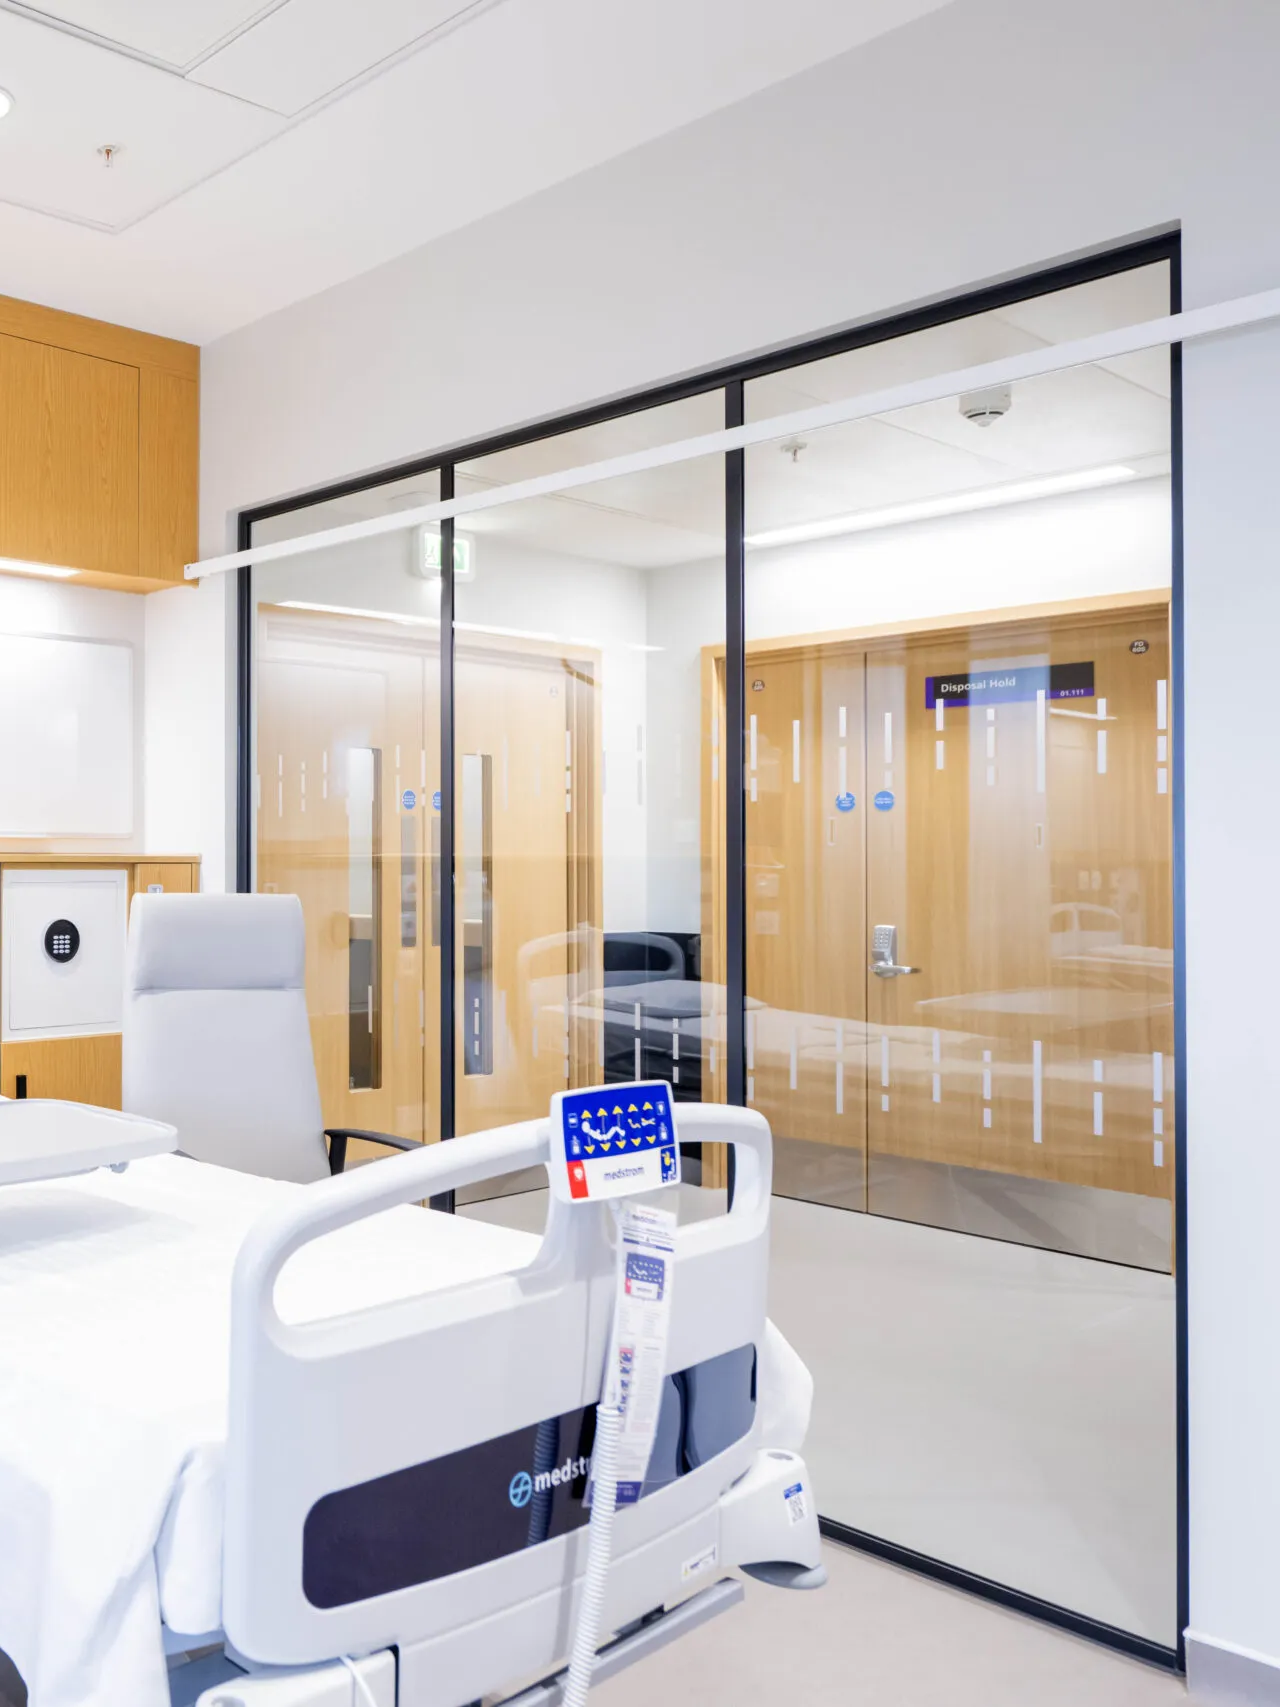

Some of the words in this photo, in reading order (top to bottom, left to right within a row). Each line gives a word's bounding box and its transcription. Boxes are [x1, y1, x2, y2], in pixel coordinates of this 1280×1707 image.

[940, 680, 986, 694] Disposal
[990, 677, 1016, 689] Hold
[1059, 688, 1085, 697] 01.111
[603, 1166, 645, 1181] medstrom
[534, 1456, 591, 1492] medst
